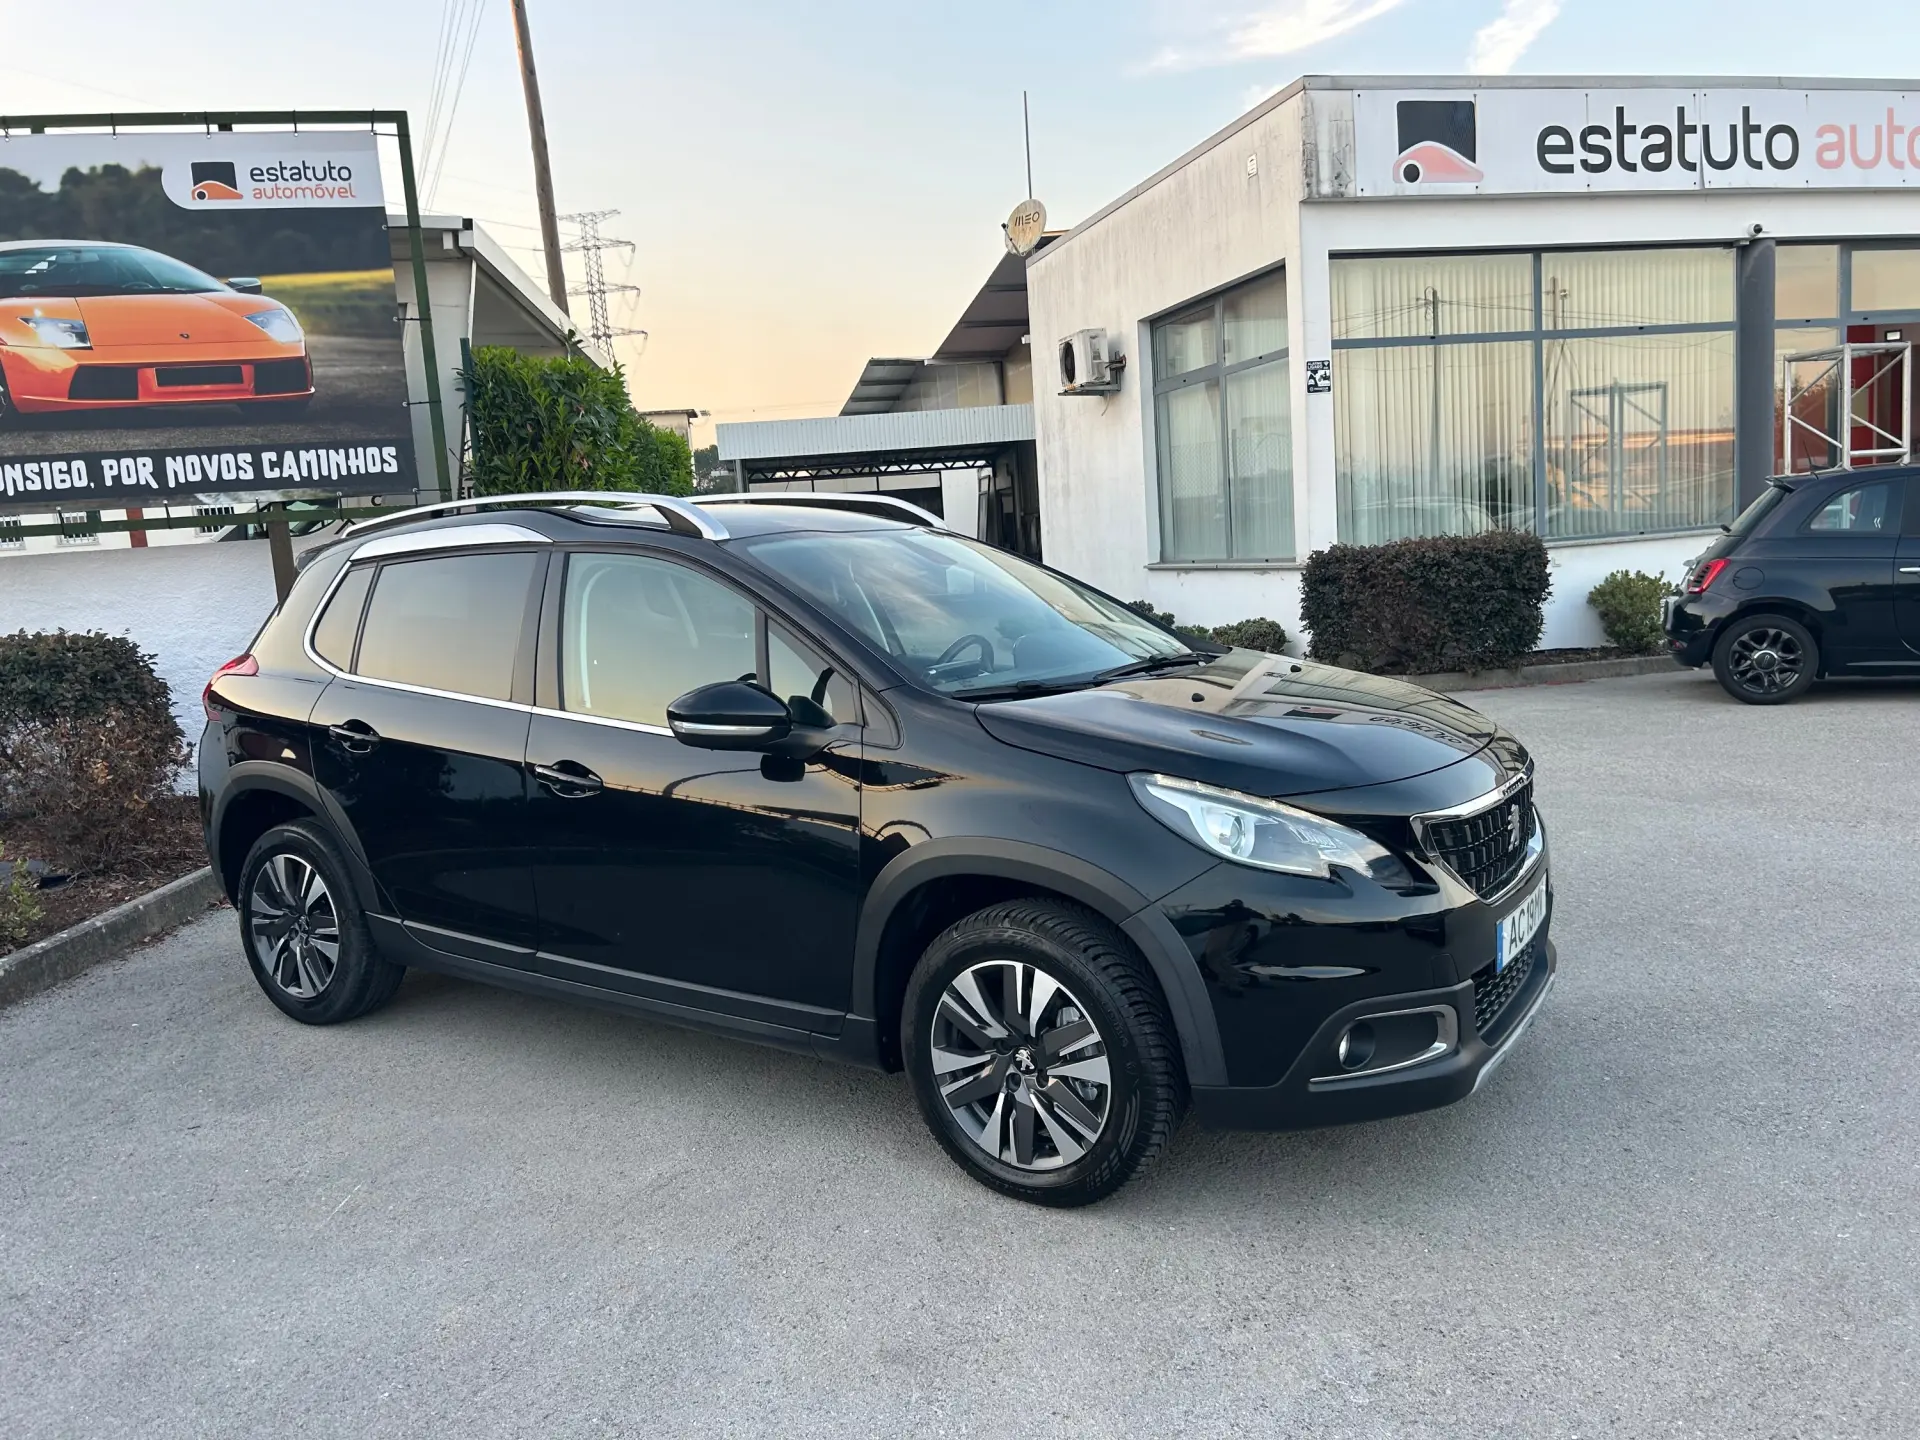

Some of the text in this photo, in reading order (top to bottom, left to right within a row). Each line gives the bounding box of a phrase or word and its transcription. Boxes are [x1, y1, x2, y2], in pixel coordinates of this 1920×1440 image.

[1536, 106, 1800, 174] estatuto
[249, 160, 352, 182] estatuto
[1014, 211, 1040, 227] MEO
[0, 446, 399, 497] NSIGO, POR NOVOS CAMINHOS
